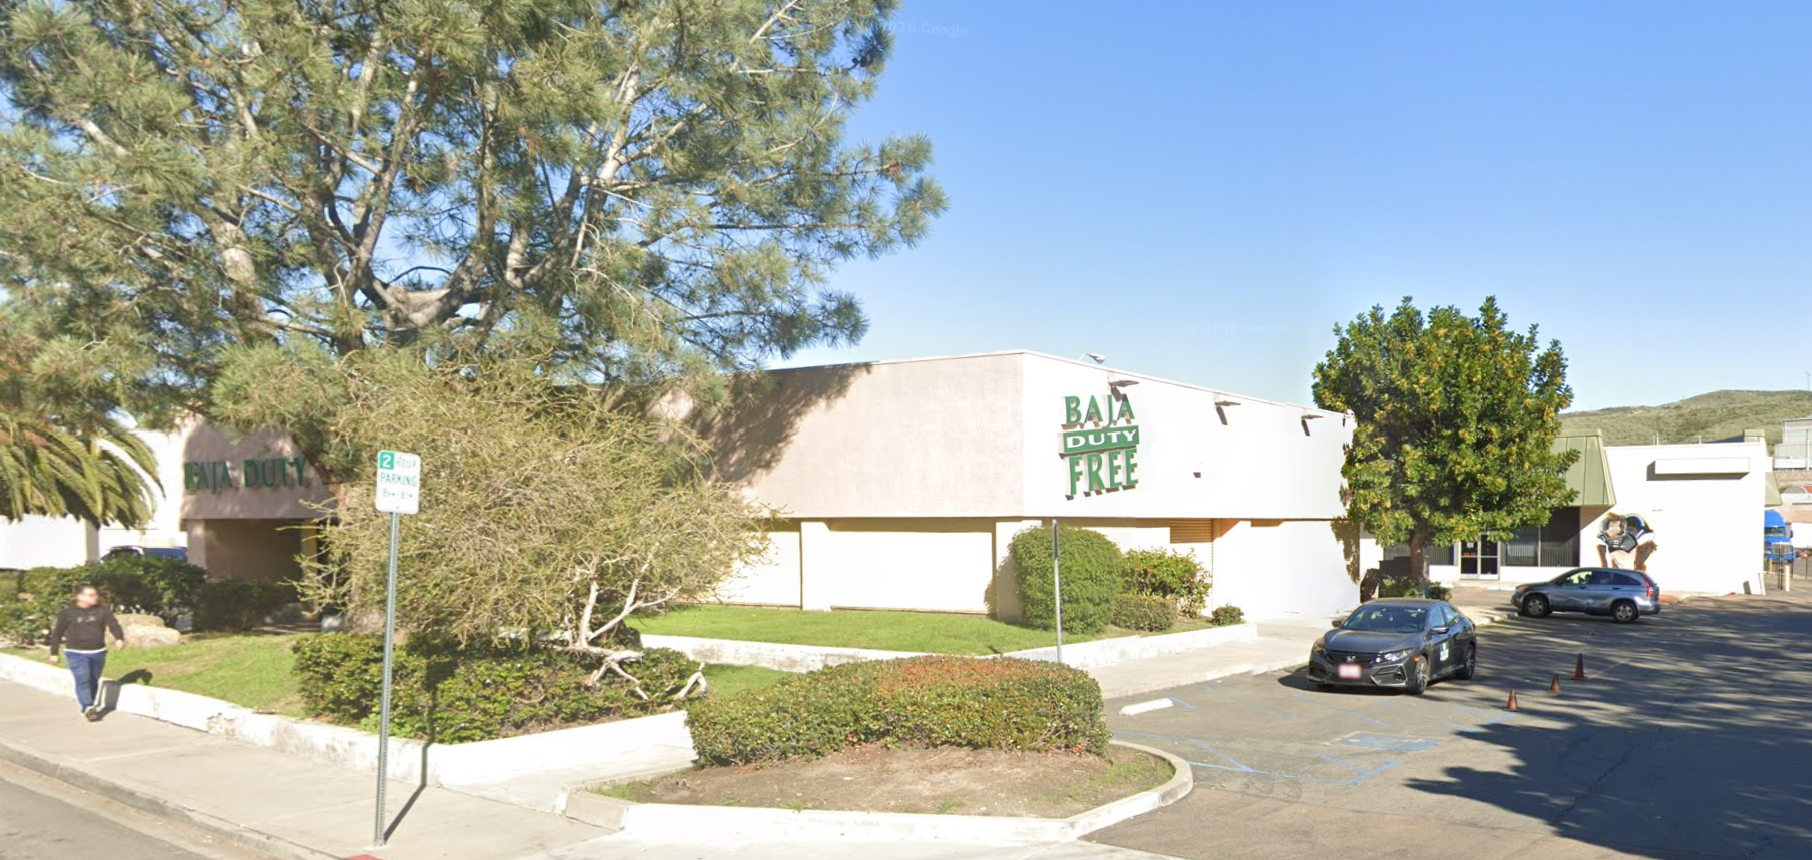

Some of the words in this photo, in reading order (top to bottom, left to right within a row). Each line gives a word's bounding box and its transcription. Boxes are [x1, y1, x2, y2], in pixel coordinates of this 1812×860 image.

[1064, 394, 1135, 428] BAJA
[1066, 429, 1138, 449] DUTY
[184, 460, 233, 492] BAJA
[243, 457, 306, 489] DUTY
[381, 454, 391, 468] 2
[1067, 448, 1139, 496] FREE
[380, 472, 417, 487] PARKING
